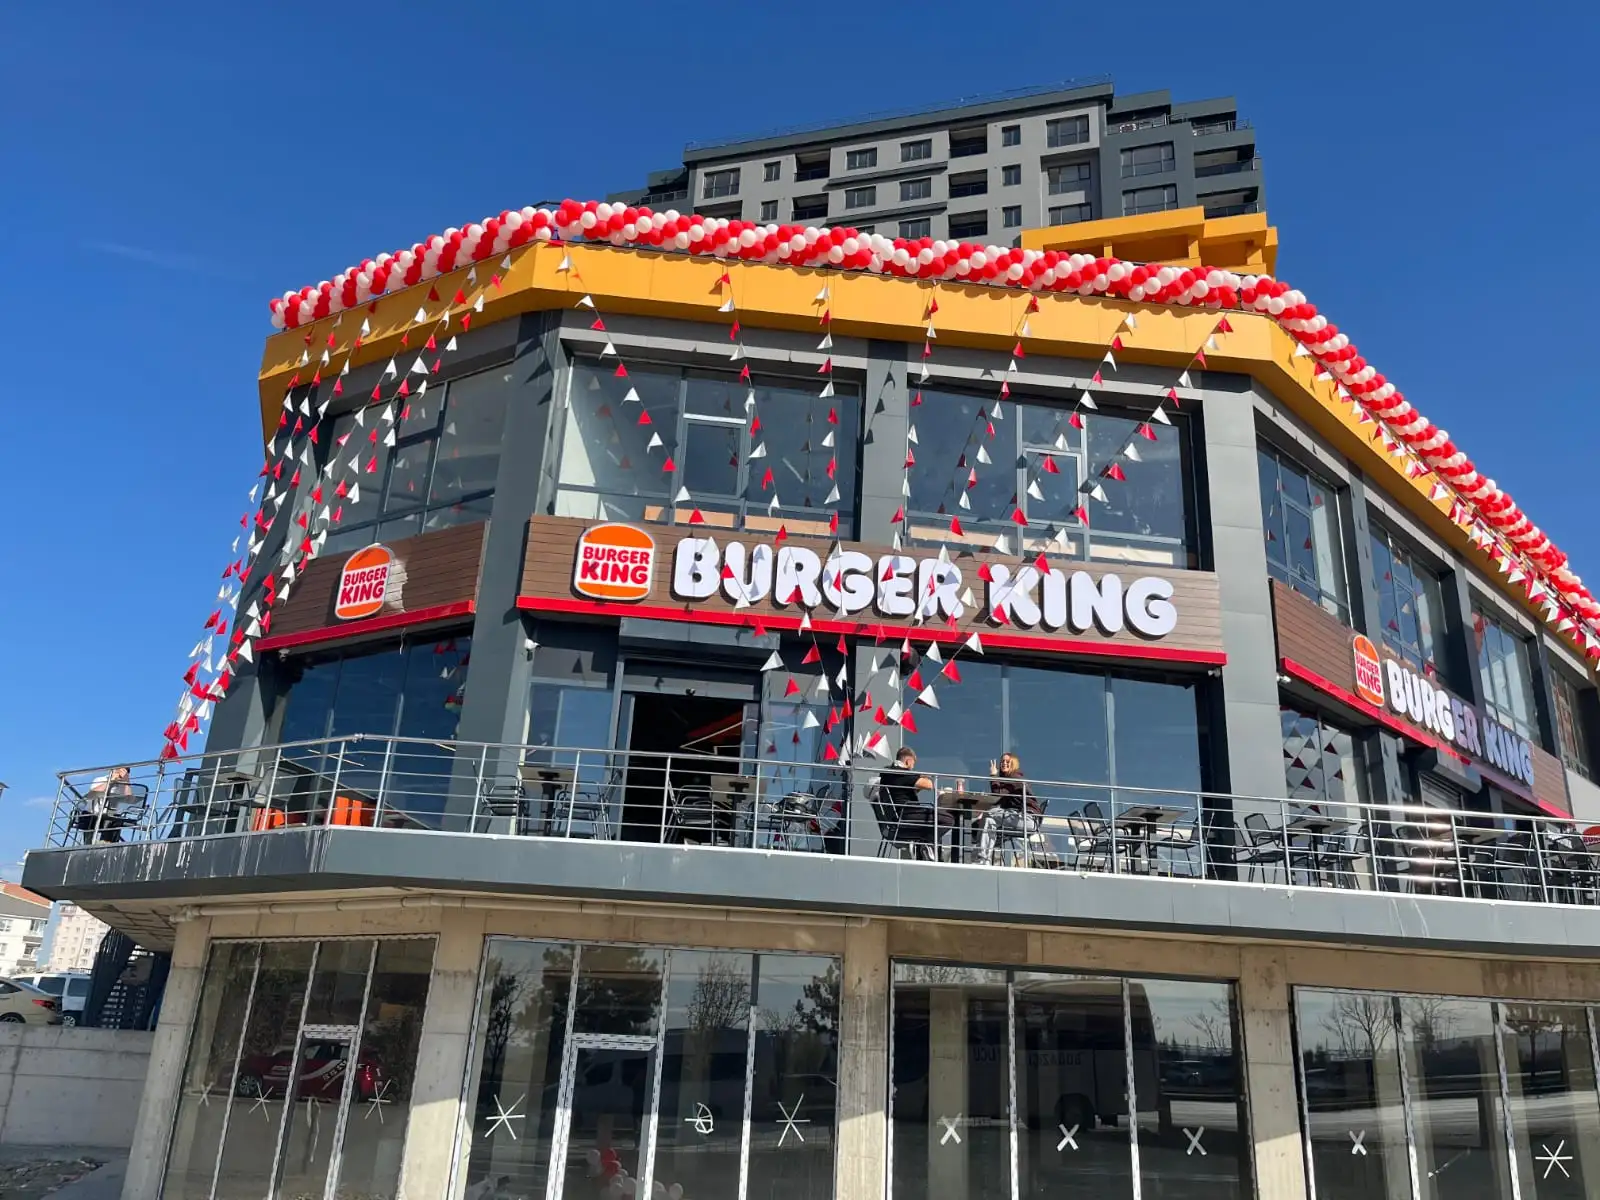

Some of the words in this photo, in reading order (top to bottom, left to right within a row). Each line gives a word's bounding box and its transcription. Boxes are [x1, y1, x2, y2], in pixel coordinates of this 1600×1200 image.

[583, 546, 650, 565] BURGER
[343, 566, 387, 587] BURGER
[580, 560, 649, 585] KING
[340, 580, 385, 605] KING
[673, 537, 964, 620] BURGER
[989, 563, 1178, 636] KING
[1355, 653, 1379, 675] BURGER
[1357, 667, 1382, 694] KING
[1386, 658, 1482, 757] BURGER
[1482, 716, 1535, 786] KING
